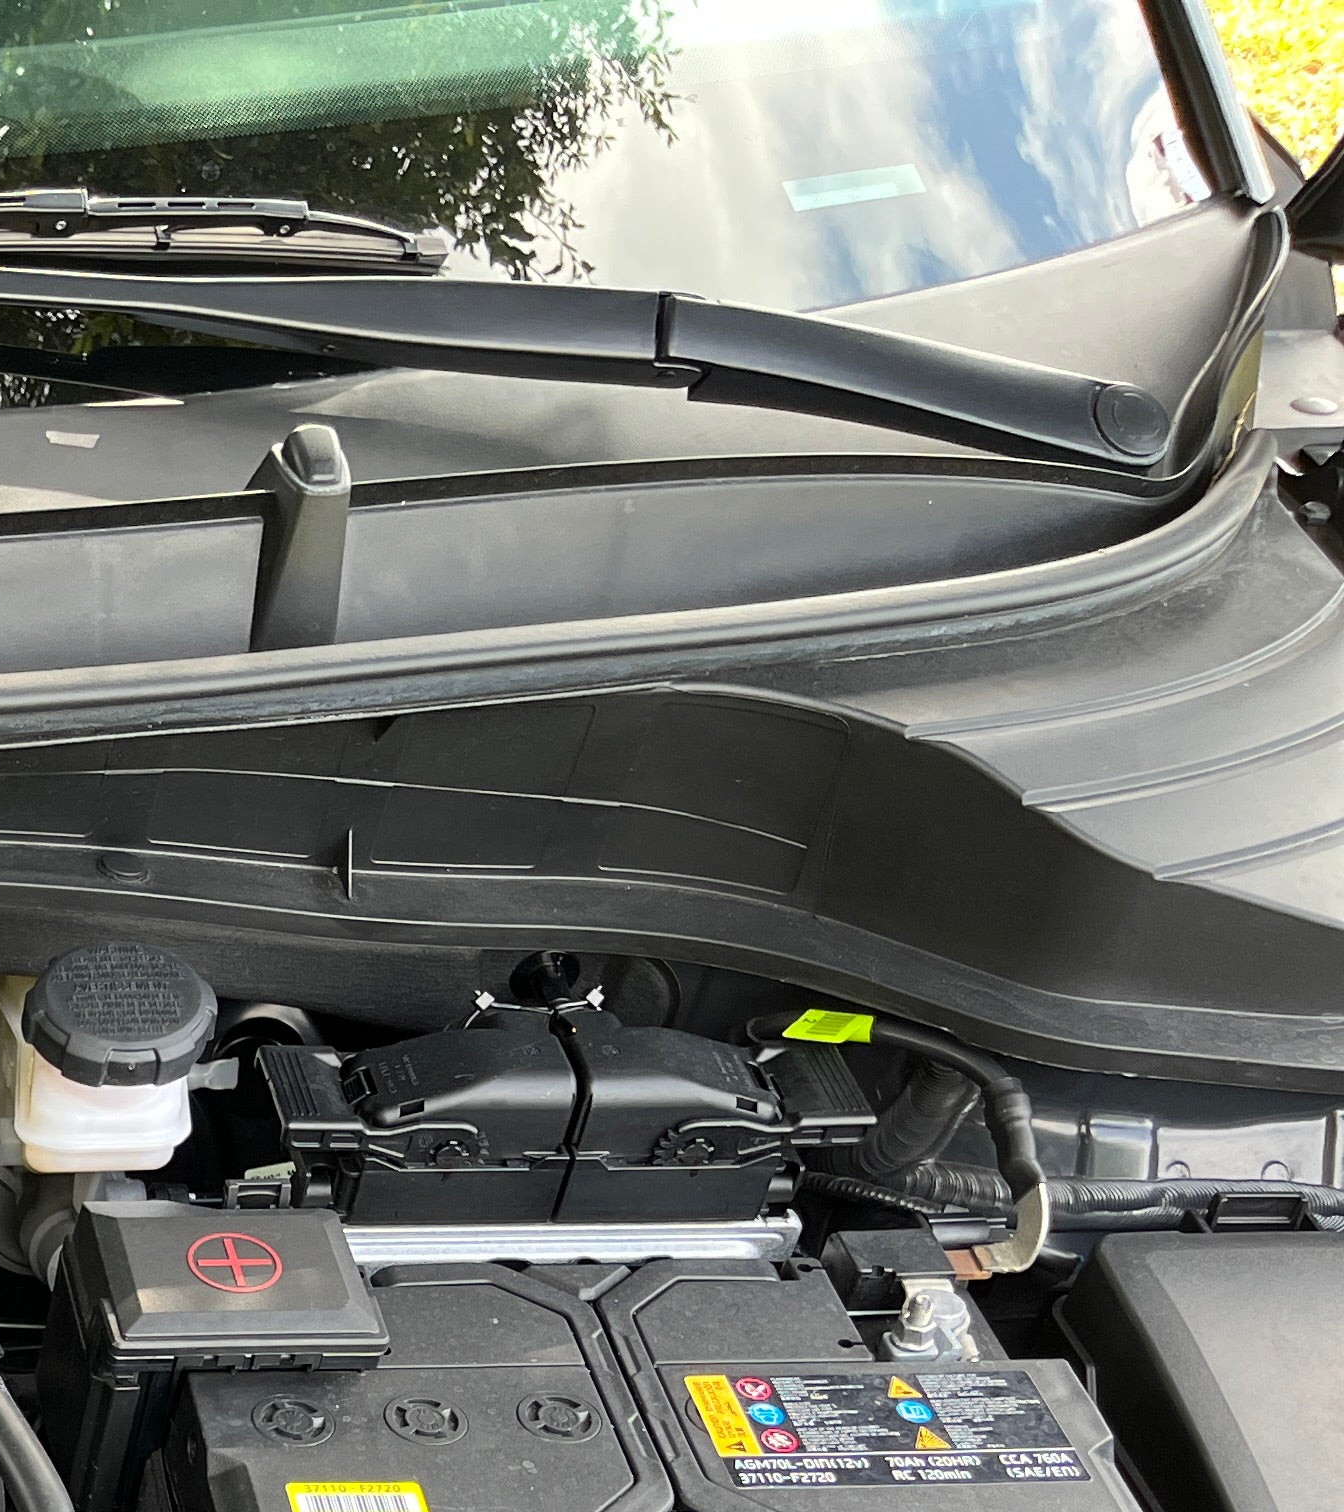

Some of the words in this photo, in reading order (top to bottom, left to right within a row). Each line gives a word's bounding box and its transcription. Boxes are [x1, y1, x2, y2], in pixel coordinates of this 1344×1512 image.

[884, 1456, 925, 1468] 70Ah
[929, 1454, 982, 1468] (20HR)
[998, 1453, 1032, 1466] CCA
[1033, 1452, 1073, 1465] 760A
[739, 1471, 837, 1485] 37110-F2720
[891, 1469, 915, 1481] RC
